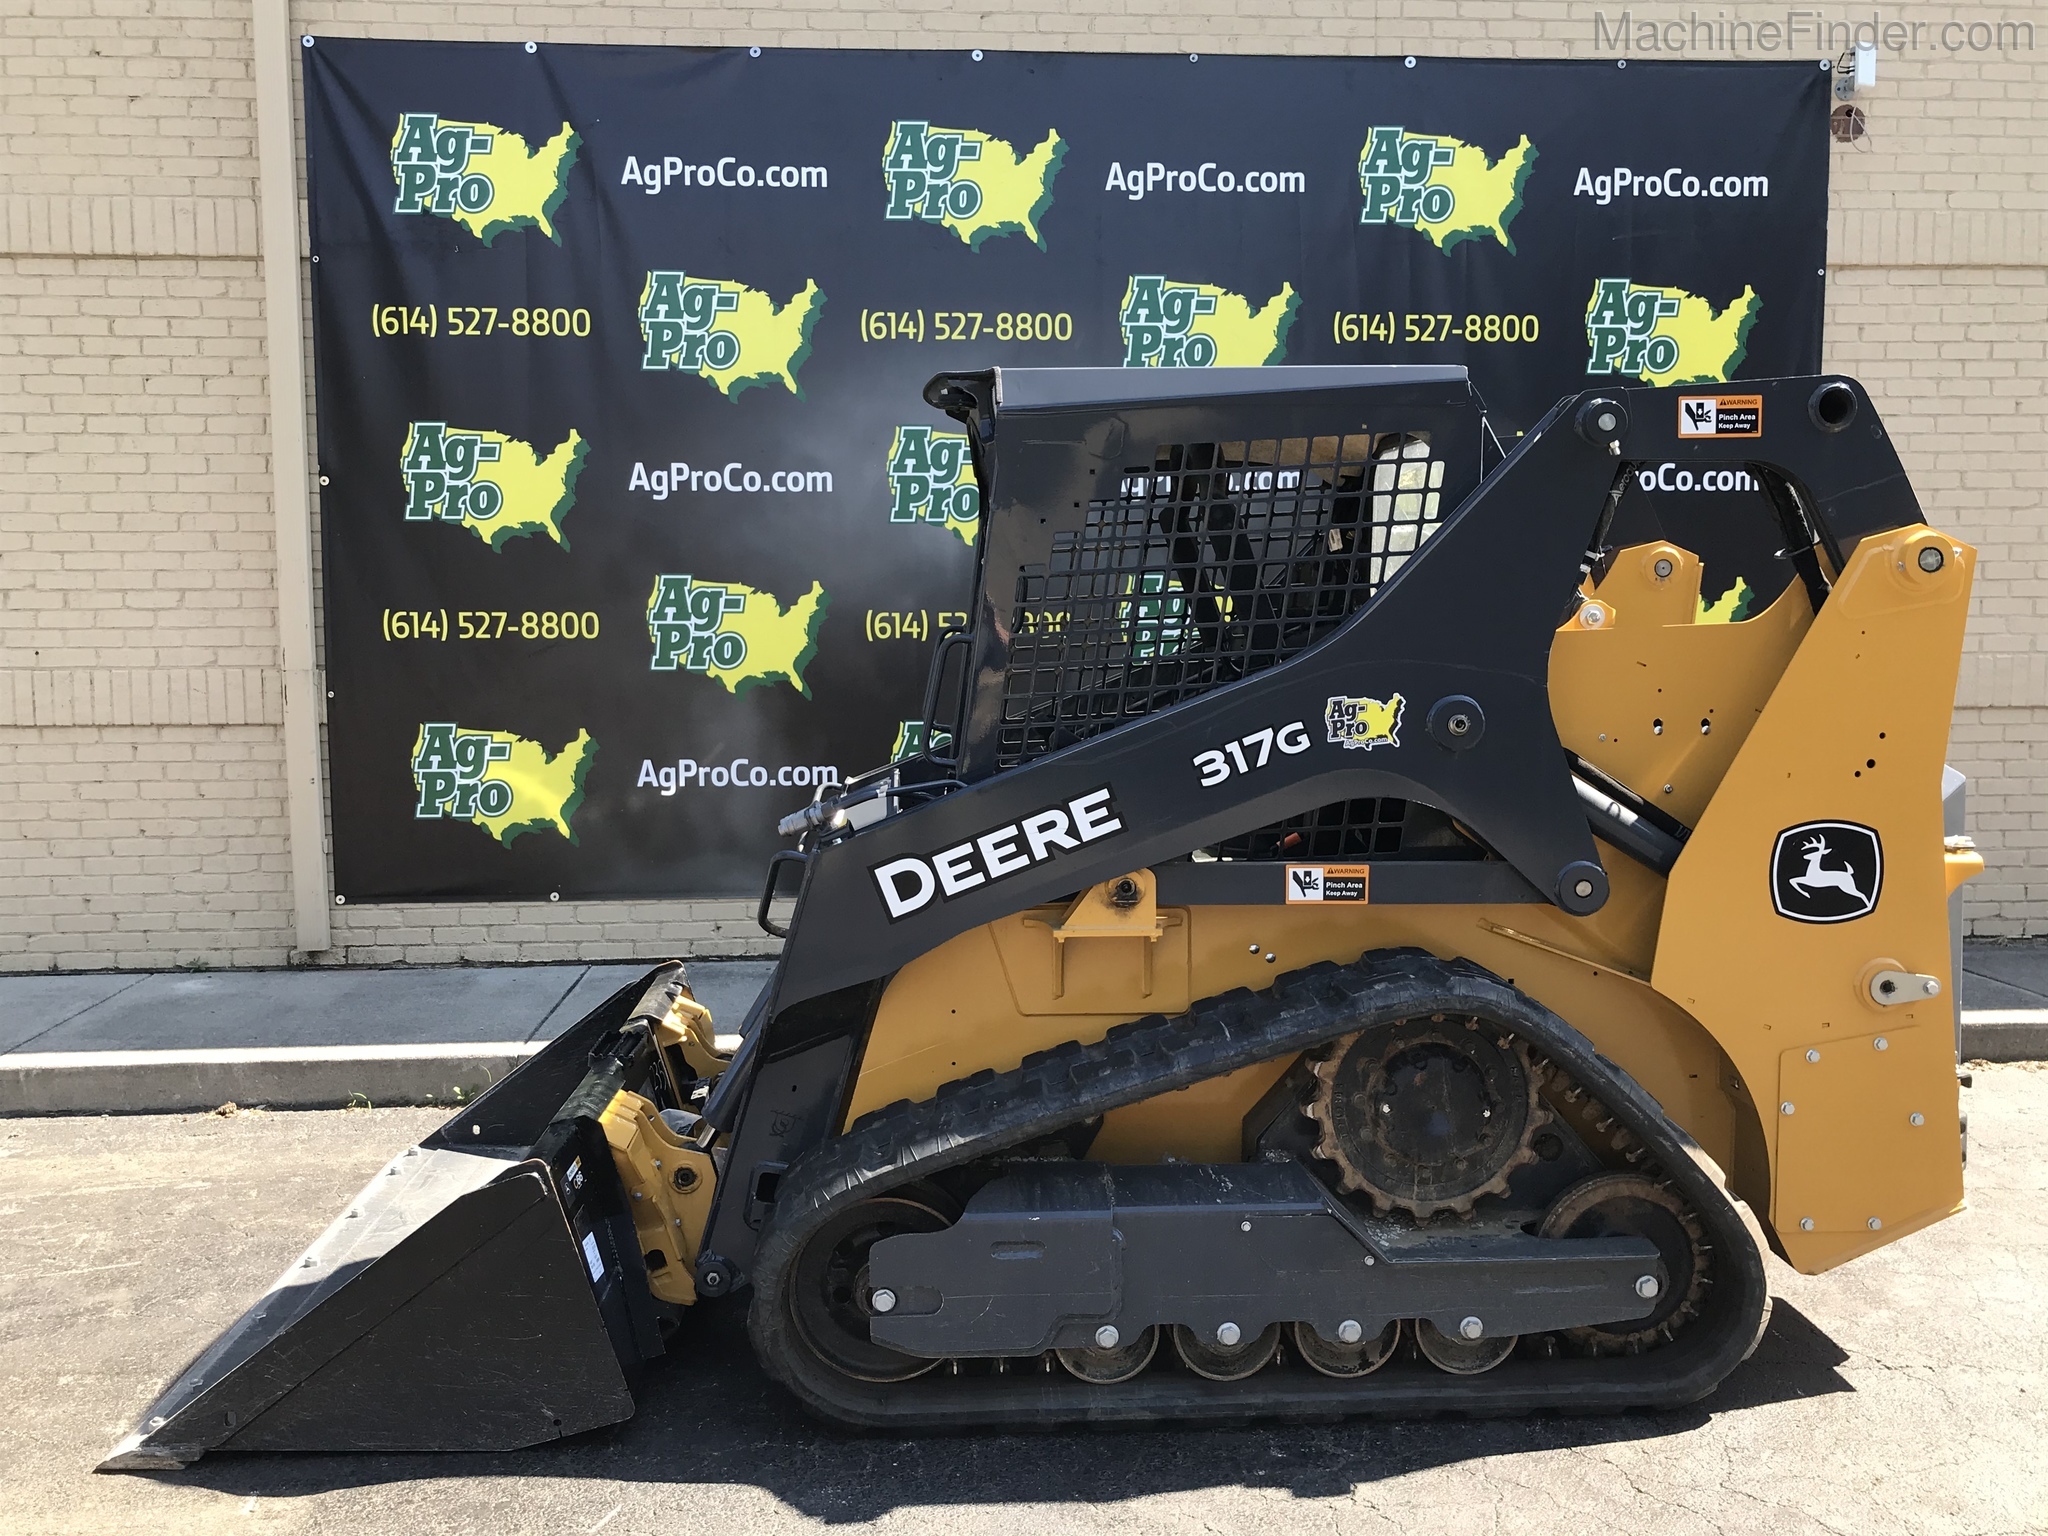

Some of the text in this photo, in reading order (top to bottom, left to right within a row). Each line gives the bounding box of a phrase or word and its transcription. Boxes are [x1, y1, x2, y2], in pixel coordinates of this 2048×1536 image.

[391, 114, 493, 174] Ag-
[882, 122, 981, 182] Ag-
[1358, 127, 1453, 187] Ag-
[392, 162, 493, 212] Pro
[620, 155, 828, 195] AgProCo.com
[883, 170, 981, 219] Pro
[1104, 161, 1305, 201] AgProCo.com
[1359, 175, 1453, 222] Pro
[1573, 167, 1769, 205] AgProCo.com
[372, 303, 591, 338] (614) 527-8800
[641, 271, 739, 331] Ag-
[1122, 276, 1217, 336] Ag-
[1588, 279, 1679, 339] Ag-
[642, 319, 739, 369] Pro
[860, 309, 1073, 342] (614) 527-8800
[1123, 324, 1217, 367] Pro
[1333, 311, 1539, 344] (614) 527-8800
[1589, 327, 1679, 373] Pro
[1718, 422, 1751, 430] Keep Away
[403, 423, 501, 483] Ag-
[404, 471, 501, 519] Pro
[629, 461, 833, 501] AgProCo.com
[890, 474, 979, 522] Pro
[383, 608, 600, 642] (614) 527-8800
[649, 575, 745, 635] Ag-
[865, 609, 928, 642] (614)
[650, 623, 745, 670] Pro
[1328, 699, 1367, 722] Ag-
[1329, 719, 1368, 738] Pro
[414, 724, 511, 784] Ag-
[636, 758, 839, 796] AgProCo.com
[1193, 721, 1311, 787] 317G
[415, 772, 511, 817] Pro
[874, 787, 1122, 918] DEERE
